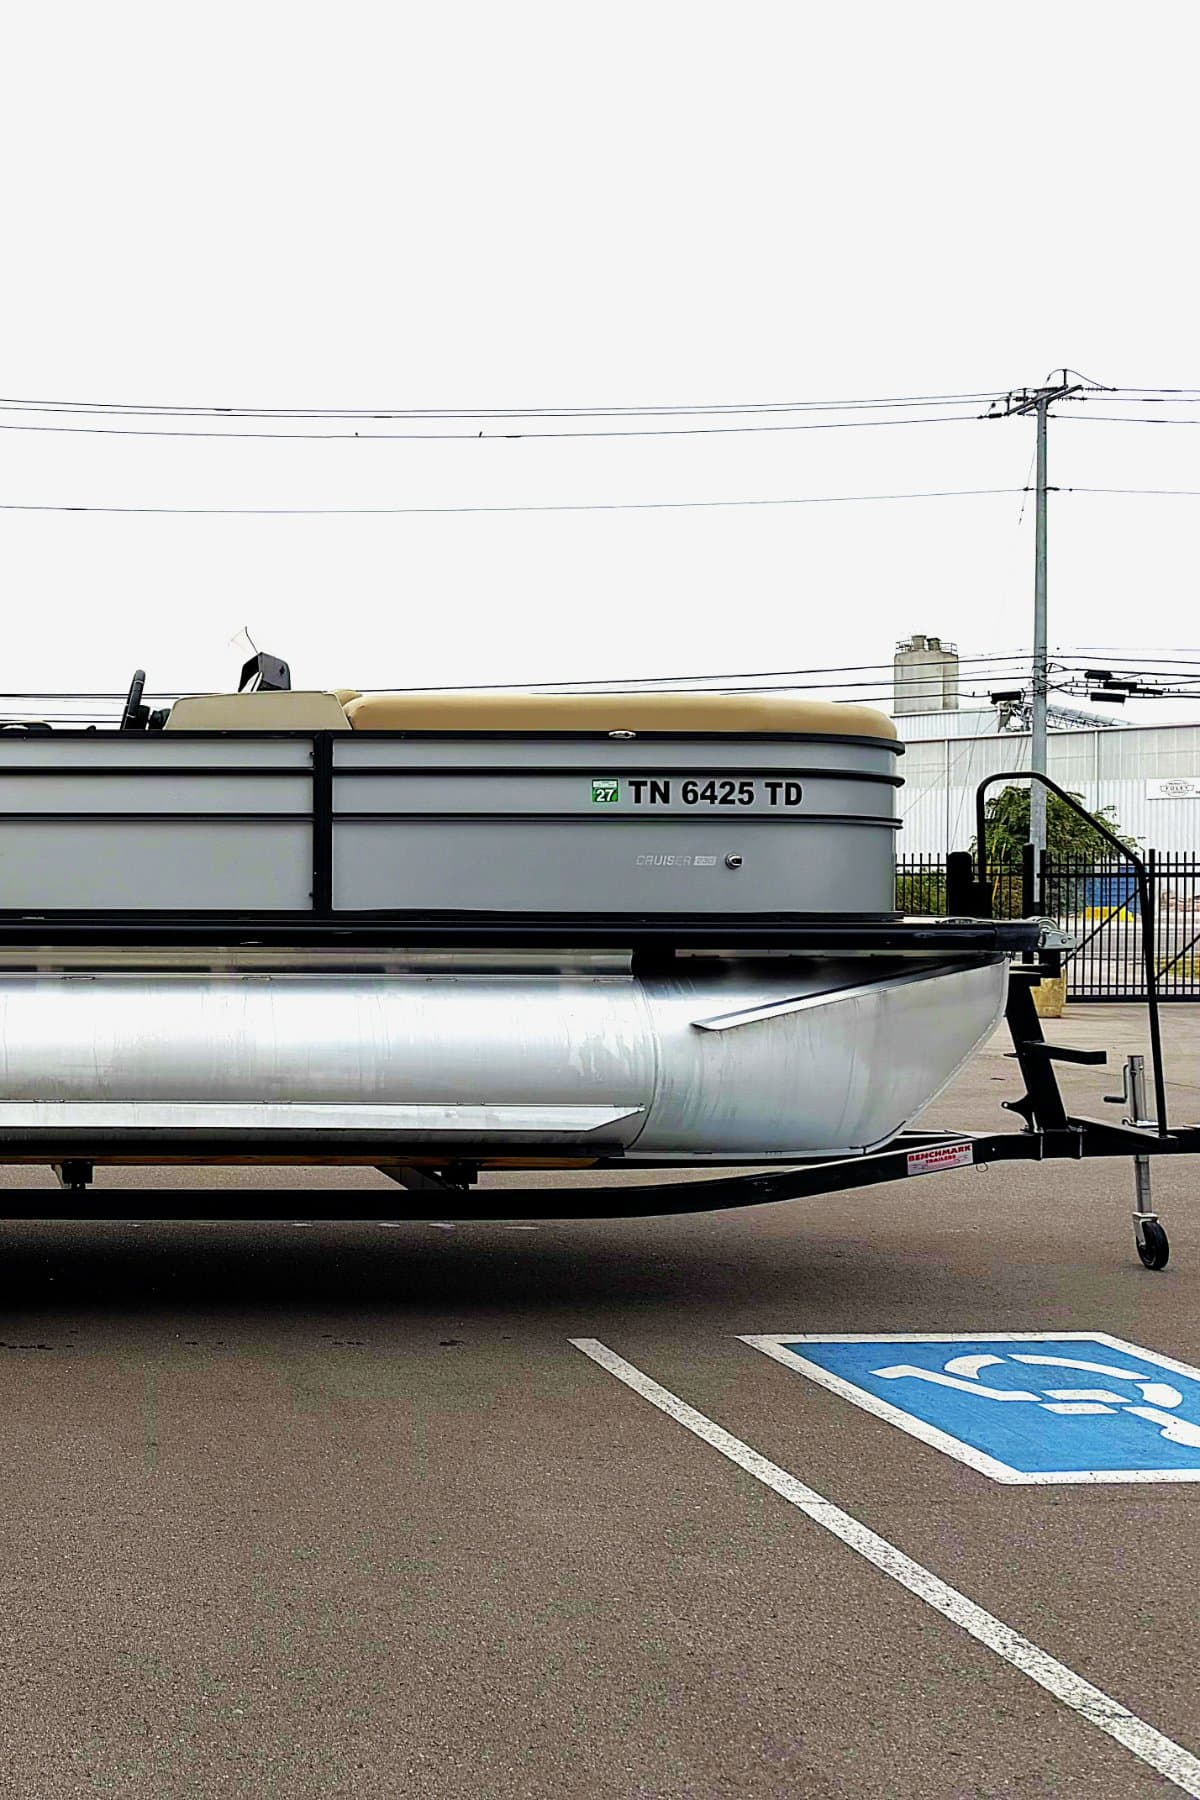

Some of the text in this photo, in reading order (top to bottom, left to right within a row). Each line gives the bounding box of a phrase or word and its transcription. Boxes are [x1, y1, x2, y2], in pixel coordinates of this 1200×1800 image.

[596, 789, 614, 802] 27
[628, 780, 803, 806] TN 6425 TD
[636, 855, 692, 866] CRUISER
[908, 1144, 971, 1162] BENCHMARK
[925, 1154, 957, 1164] TRAILERS
